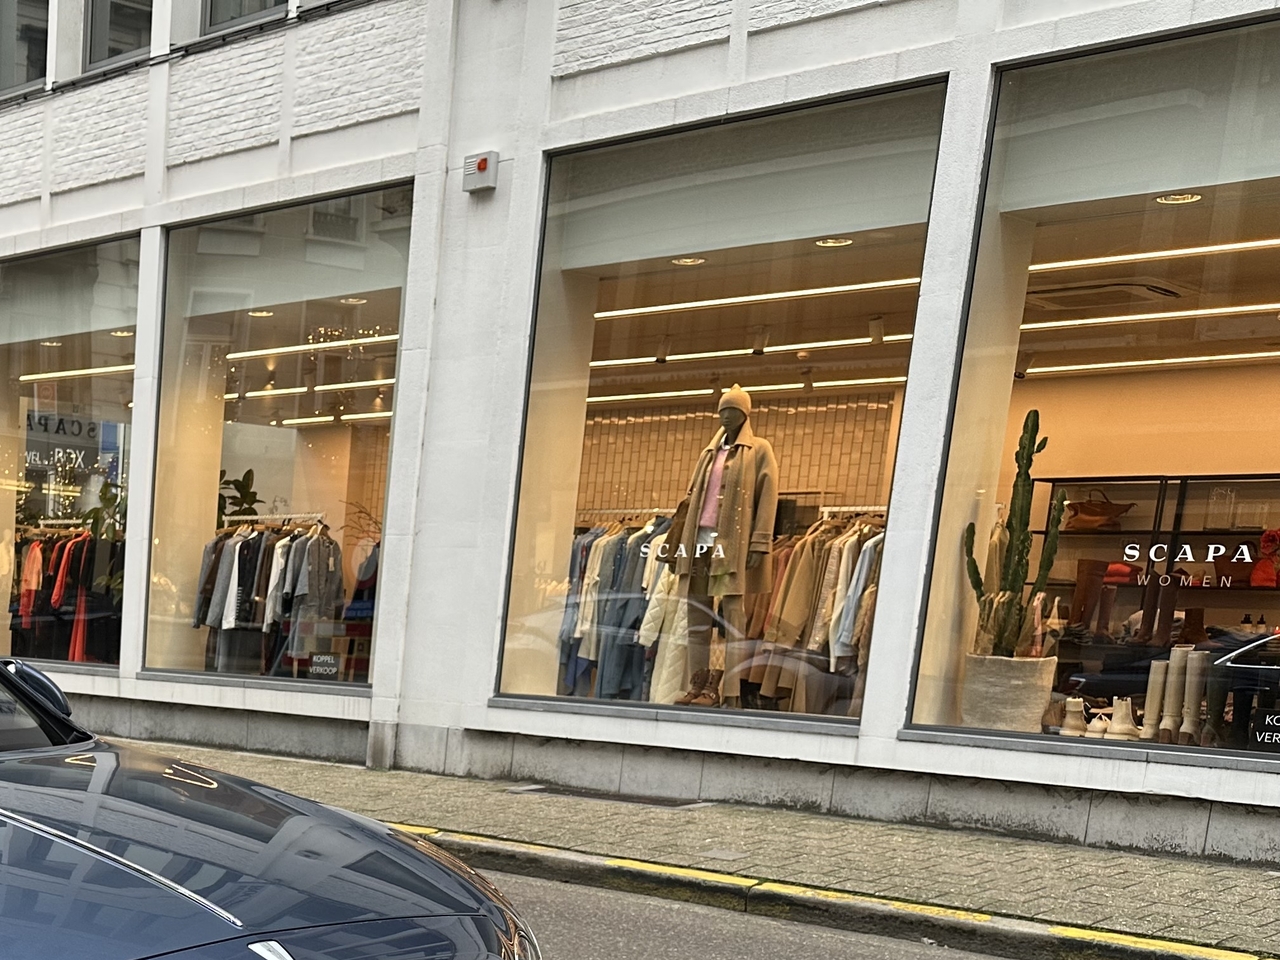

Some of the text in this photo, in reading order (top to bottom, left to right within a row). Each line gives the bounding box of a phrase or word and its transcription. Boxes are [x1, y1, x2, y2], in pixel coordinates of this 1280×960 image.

[640, 543, 725, 559] SCAPA
[1123, 543, 1253, 563] SCAPA
[1136, 574, 1232, 588] WOMEN
[312, 655, 335, 664] KOPPEL
[309, 666, 338, 676] VERKOOP
